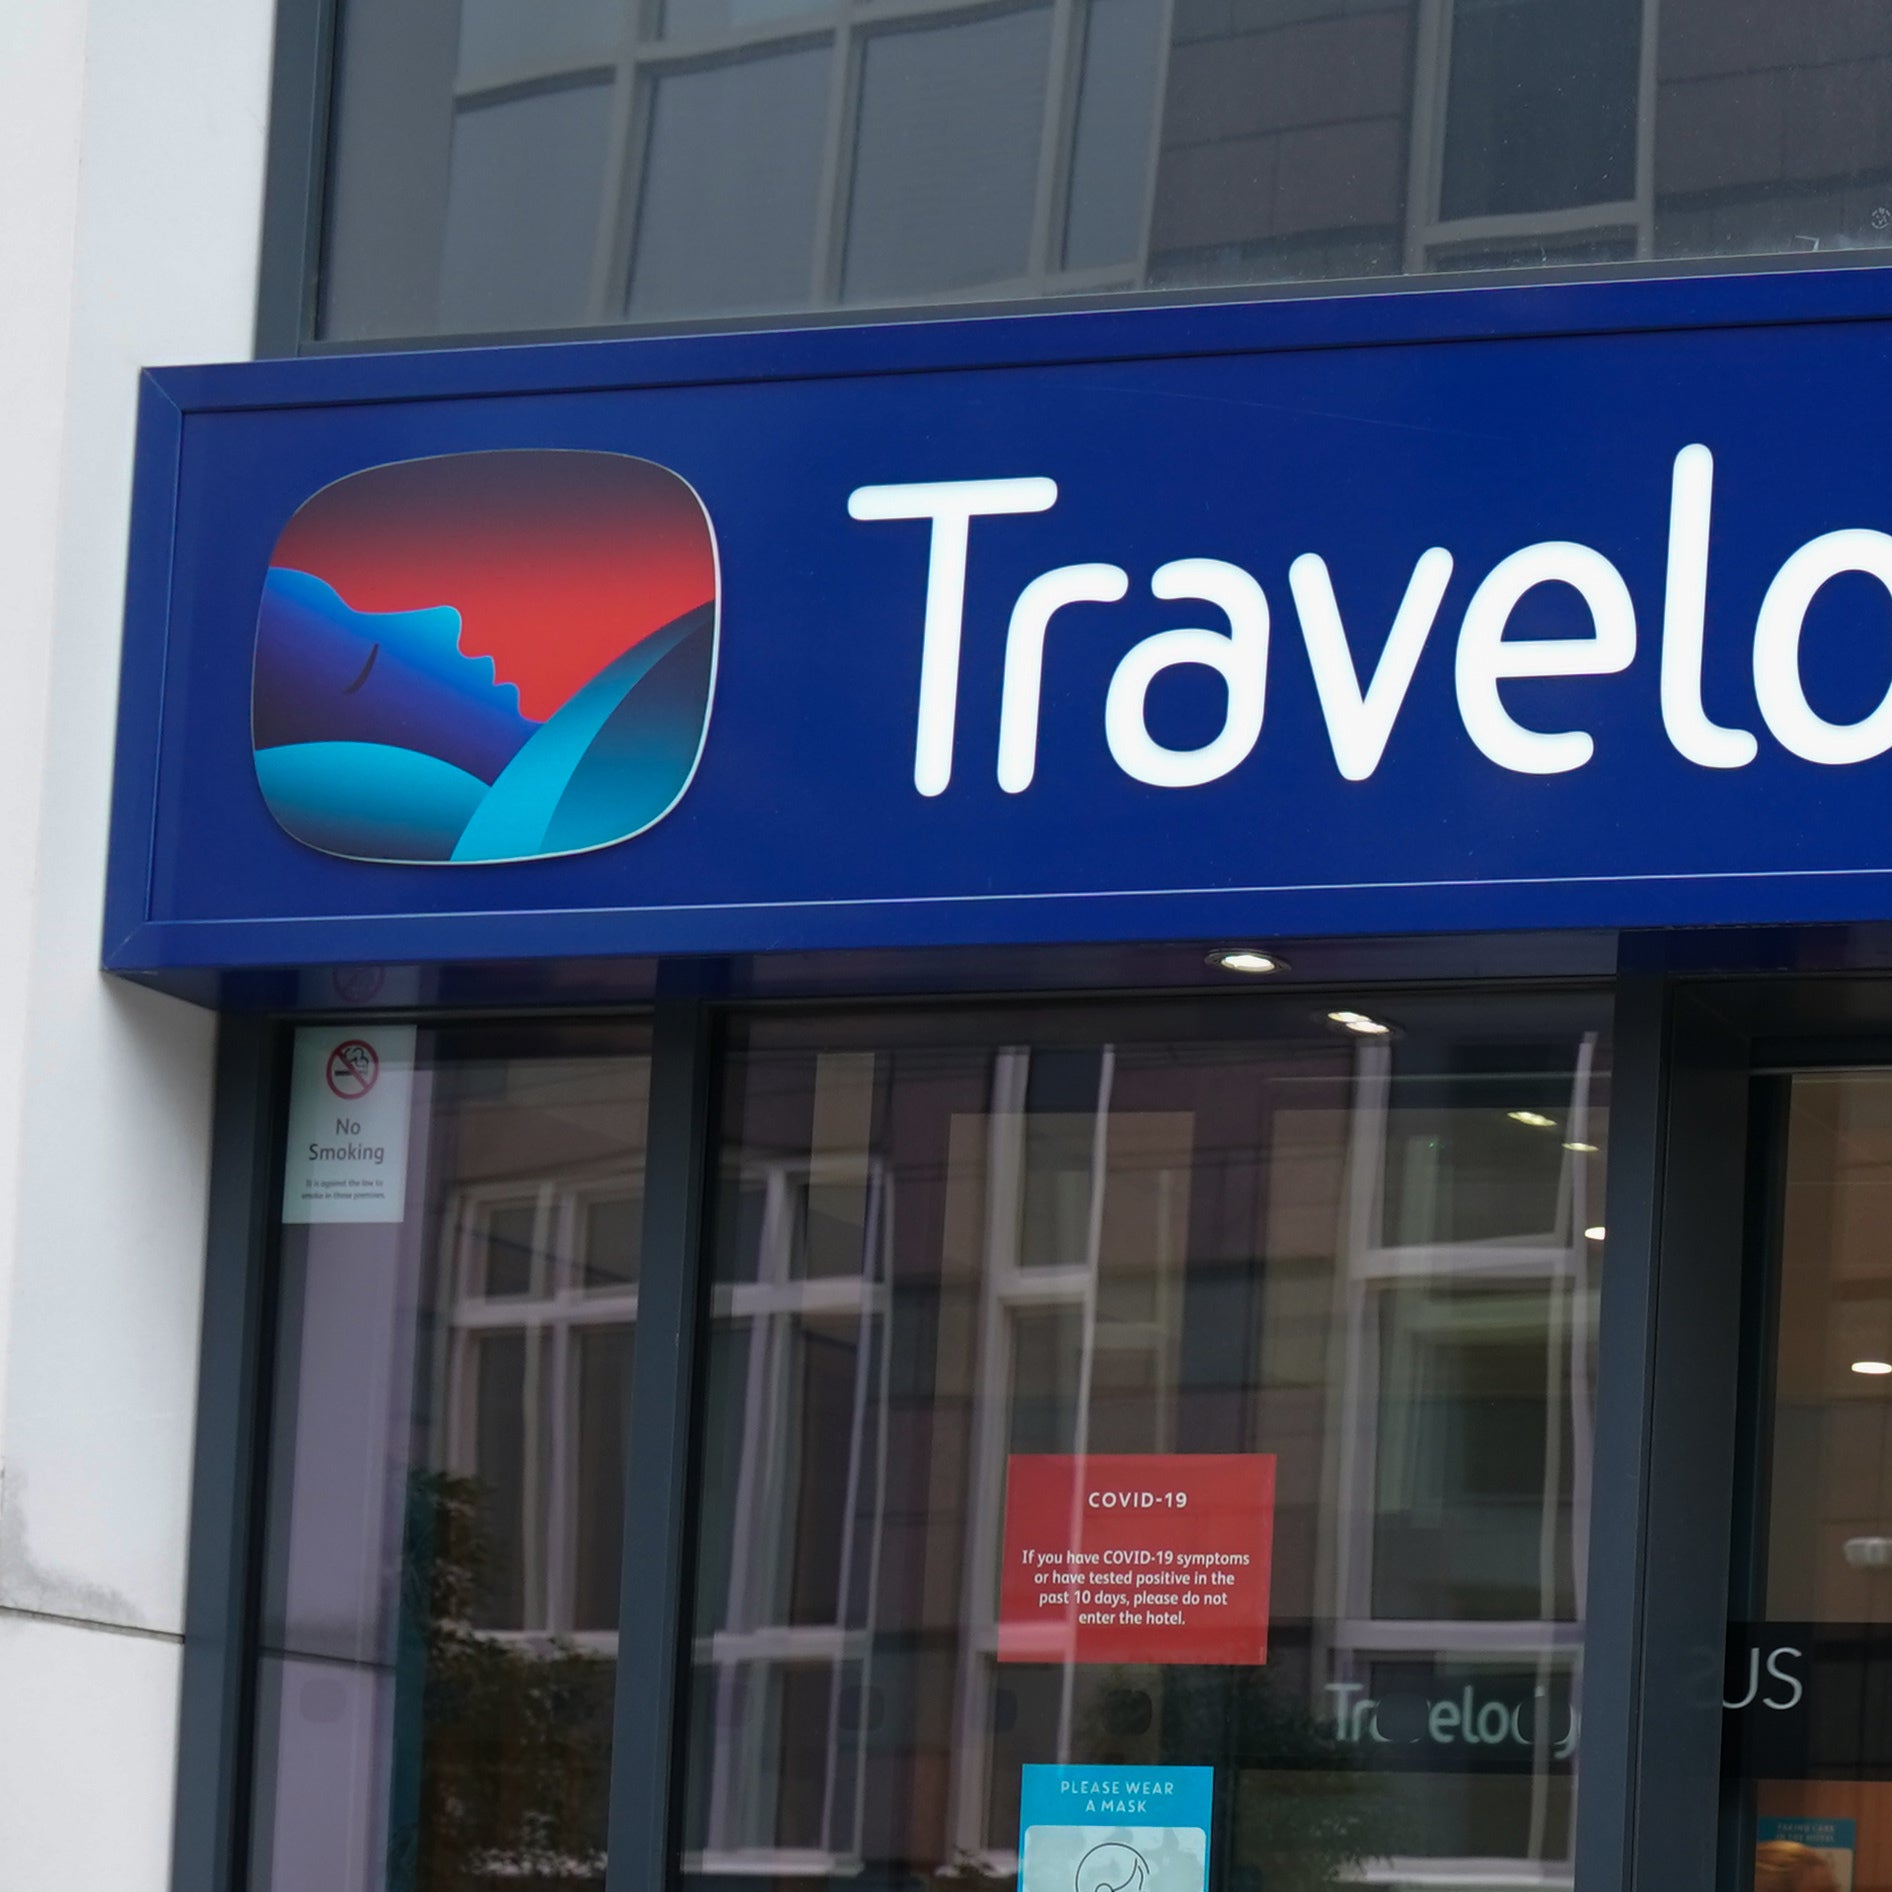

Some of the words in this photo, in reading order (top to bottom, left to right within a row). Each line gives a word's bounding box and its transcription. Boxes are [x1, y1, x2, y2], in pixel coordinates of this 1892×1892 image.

[336, 1118, 361, 1135] No
[309, 1143, 385, 1164] Smoking
[1088, 1492, 1188, 1508] COVID-19
[1022, 1549, 1035, 1564] If
[1036, 1553, 1063, 1568] you
[1066, 1550, 1100, 1565] have
[1103, 1550, 1174, 1565] COVID-19
[1177, 1552, 1250, 1568] symptoms
[1034, 1573, 1049, 1584] or
[1052, 1571, 1086, 1584] have
[1089, 1571, 1132, 1585] tested
[1136, 1571, 1190, 1588] positive
[1194, 1571, 1207, 1585] in
[1211, 1571, 1235, 1585] the
[1039, 1591, 1070, 1607] past
[1074, 1590, 1091, 1604] 10
[1094, 1590, 1130, 1608] days,
[1133, 1590, 1178, 1607] please
[1182, 1590, 1200, 1605] do
[1203, 1592, 1228, 1605] not
[1078, 1612, 1115, 1625] enter
[1119, 1611, 1143, 1625] the
[1146, 1611, 1185, 1625] hotel.
[1060, 1781, 1120, 1795] PLEASE
[1126, 1782, 1174, 1795] WEAR
[1085, 1800, 1096, 1812] A
[1101, 1800, 1147, 1813] MASK
